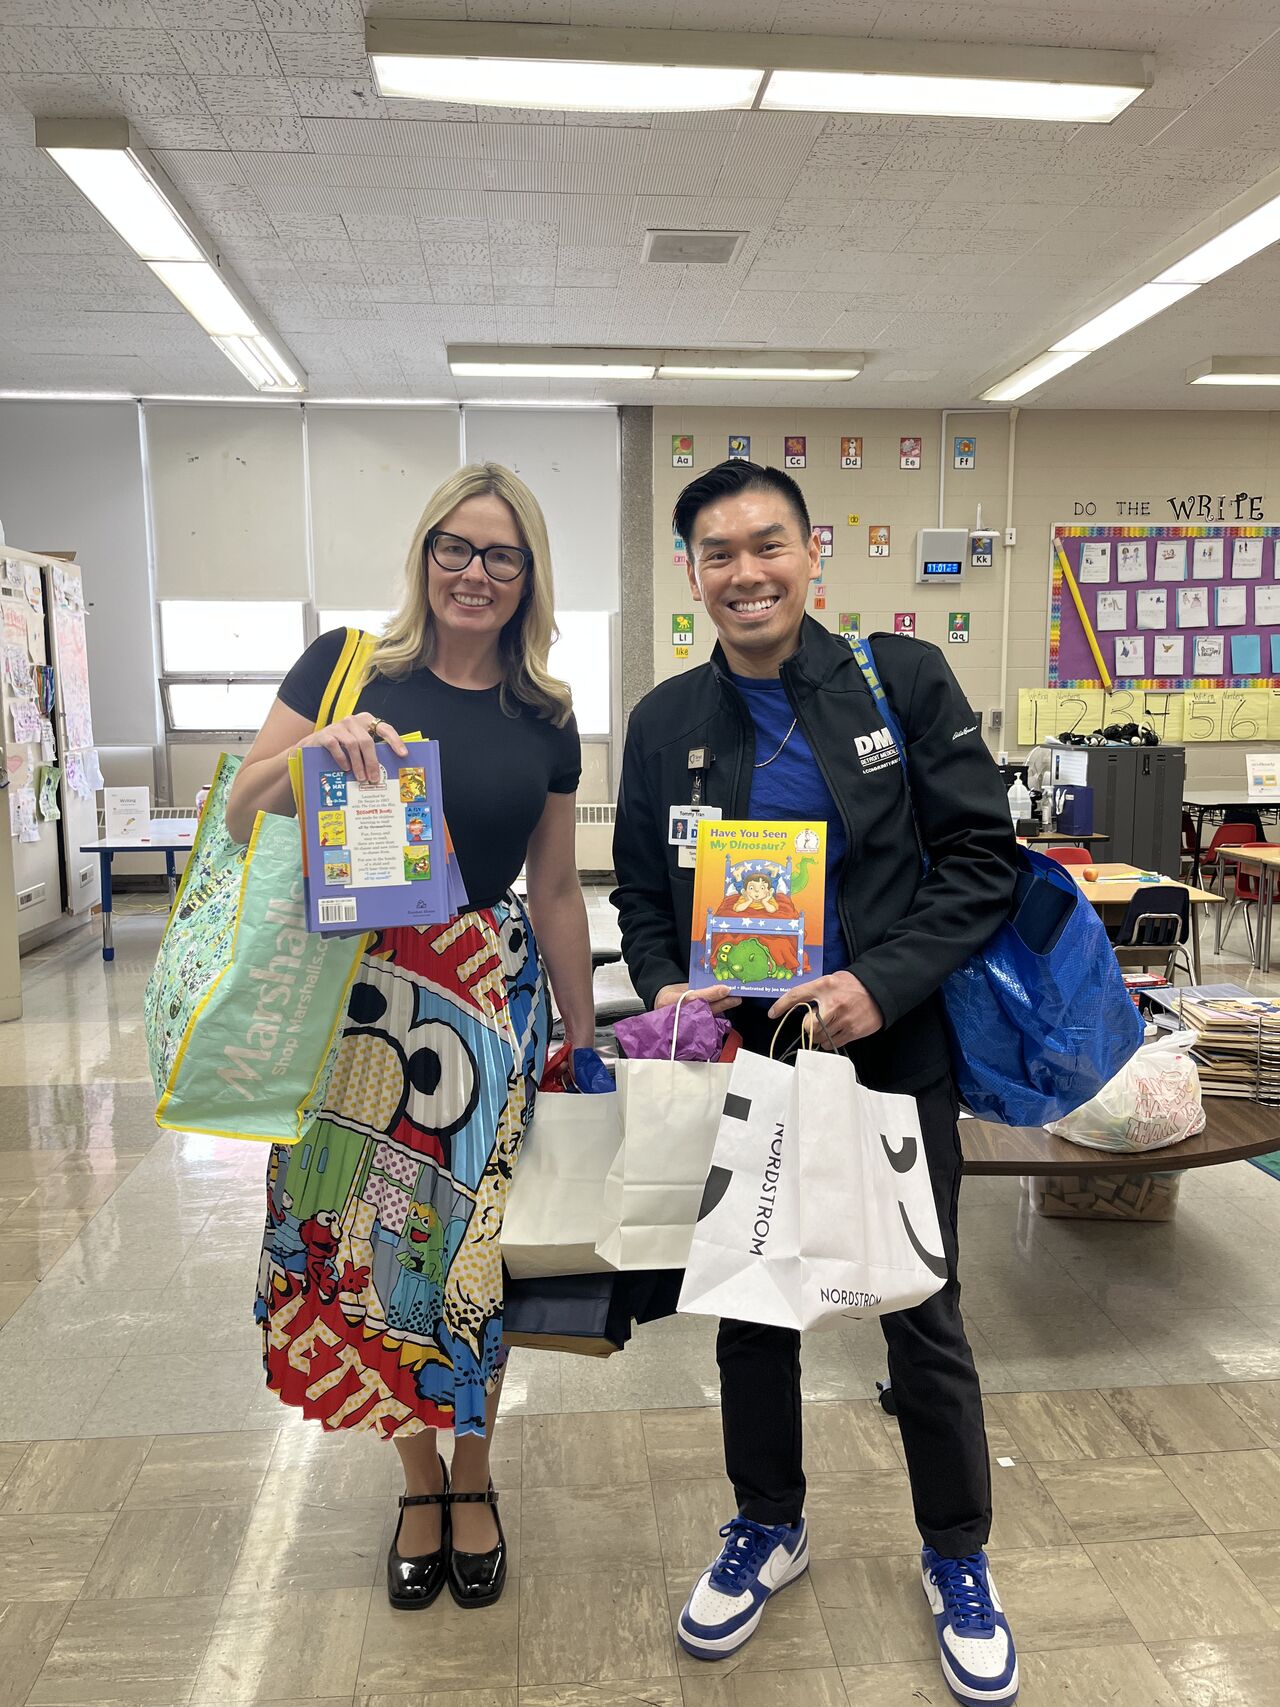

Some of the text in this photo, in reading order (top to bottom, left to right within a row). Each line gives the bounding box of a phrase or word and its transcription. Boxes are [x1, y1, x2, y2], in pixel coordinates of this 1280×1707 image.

[676, 456, 688, 465] Aa
[790, 457, 801, 466] Cc
[846, 457, 858, 466] Dd
[905, 458, 916, 467] Ee
[960, 457, 969, 466] Ff
[1074, 492, 1264, 522] DO THE WRITE
[875, 546, 883, 555] Jj
[976, 556, 988, 564] Kk
[951, 632, 965, 642] Qq
[676, 648, 688, 656] like
[1060, 698, 1088, 734] 2
[1108, 690, 1135, 724] 3
[1189, 700, 1217, 739] 5
[1229, 700, 1259, 739] 6
[854, 727, 894, 757] DM
[860, 754, 880, 766] DETROIT
[691, 829, 698, 838] D
[710, 829, 788, 839] Have You Seen
[710, 840, 786, 851] My Dinosaur?
[272, 940, 329, 1075] Shop Marshalls.c
[1125, 1112, 1180, 1145] THANK
[750, 1122, 784, 1256] NORDSTROM
